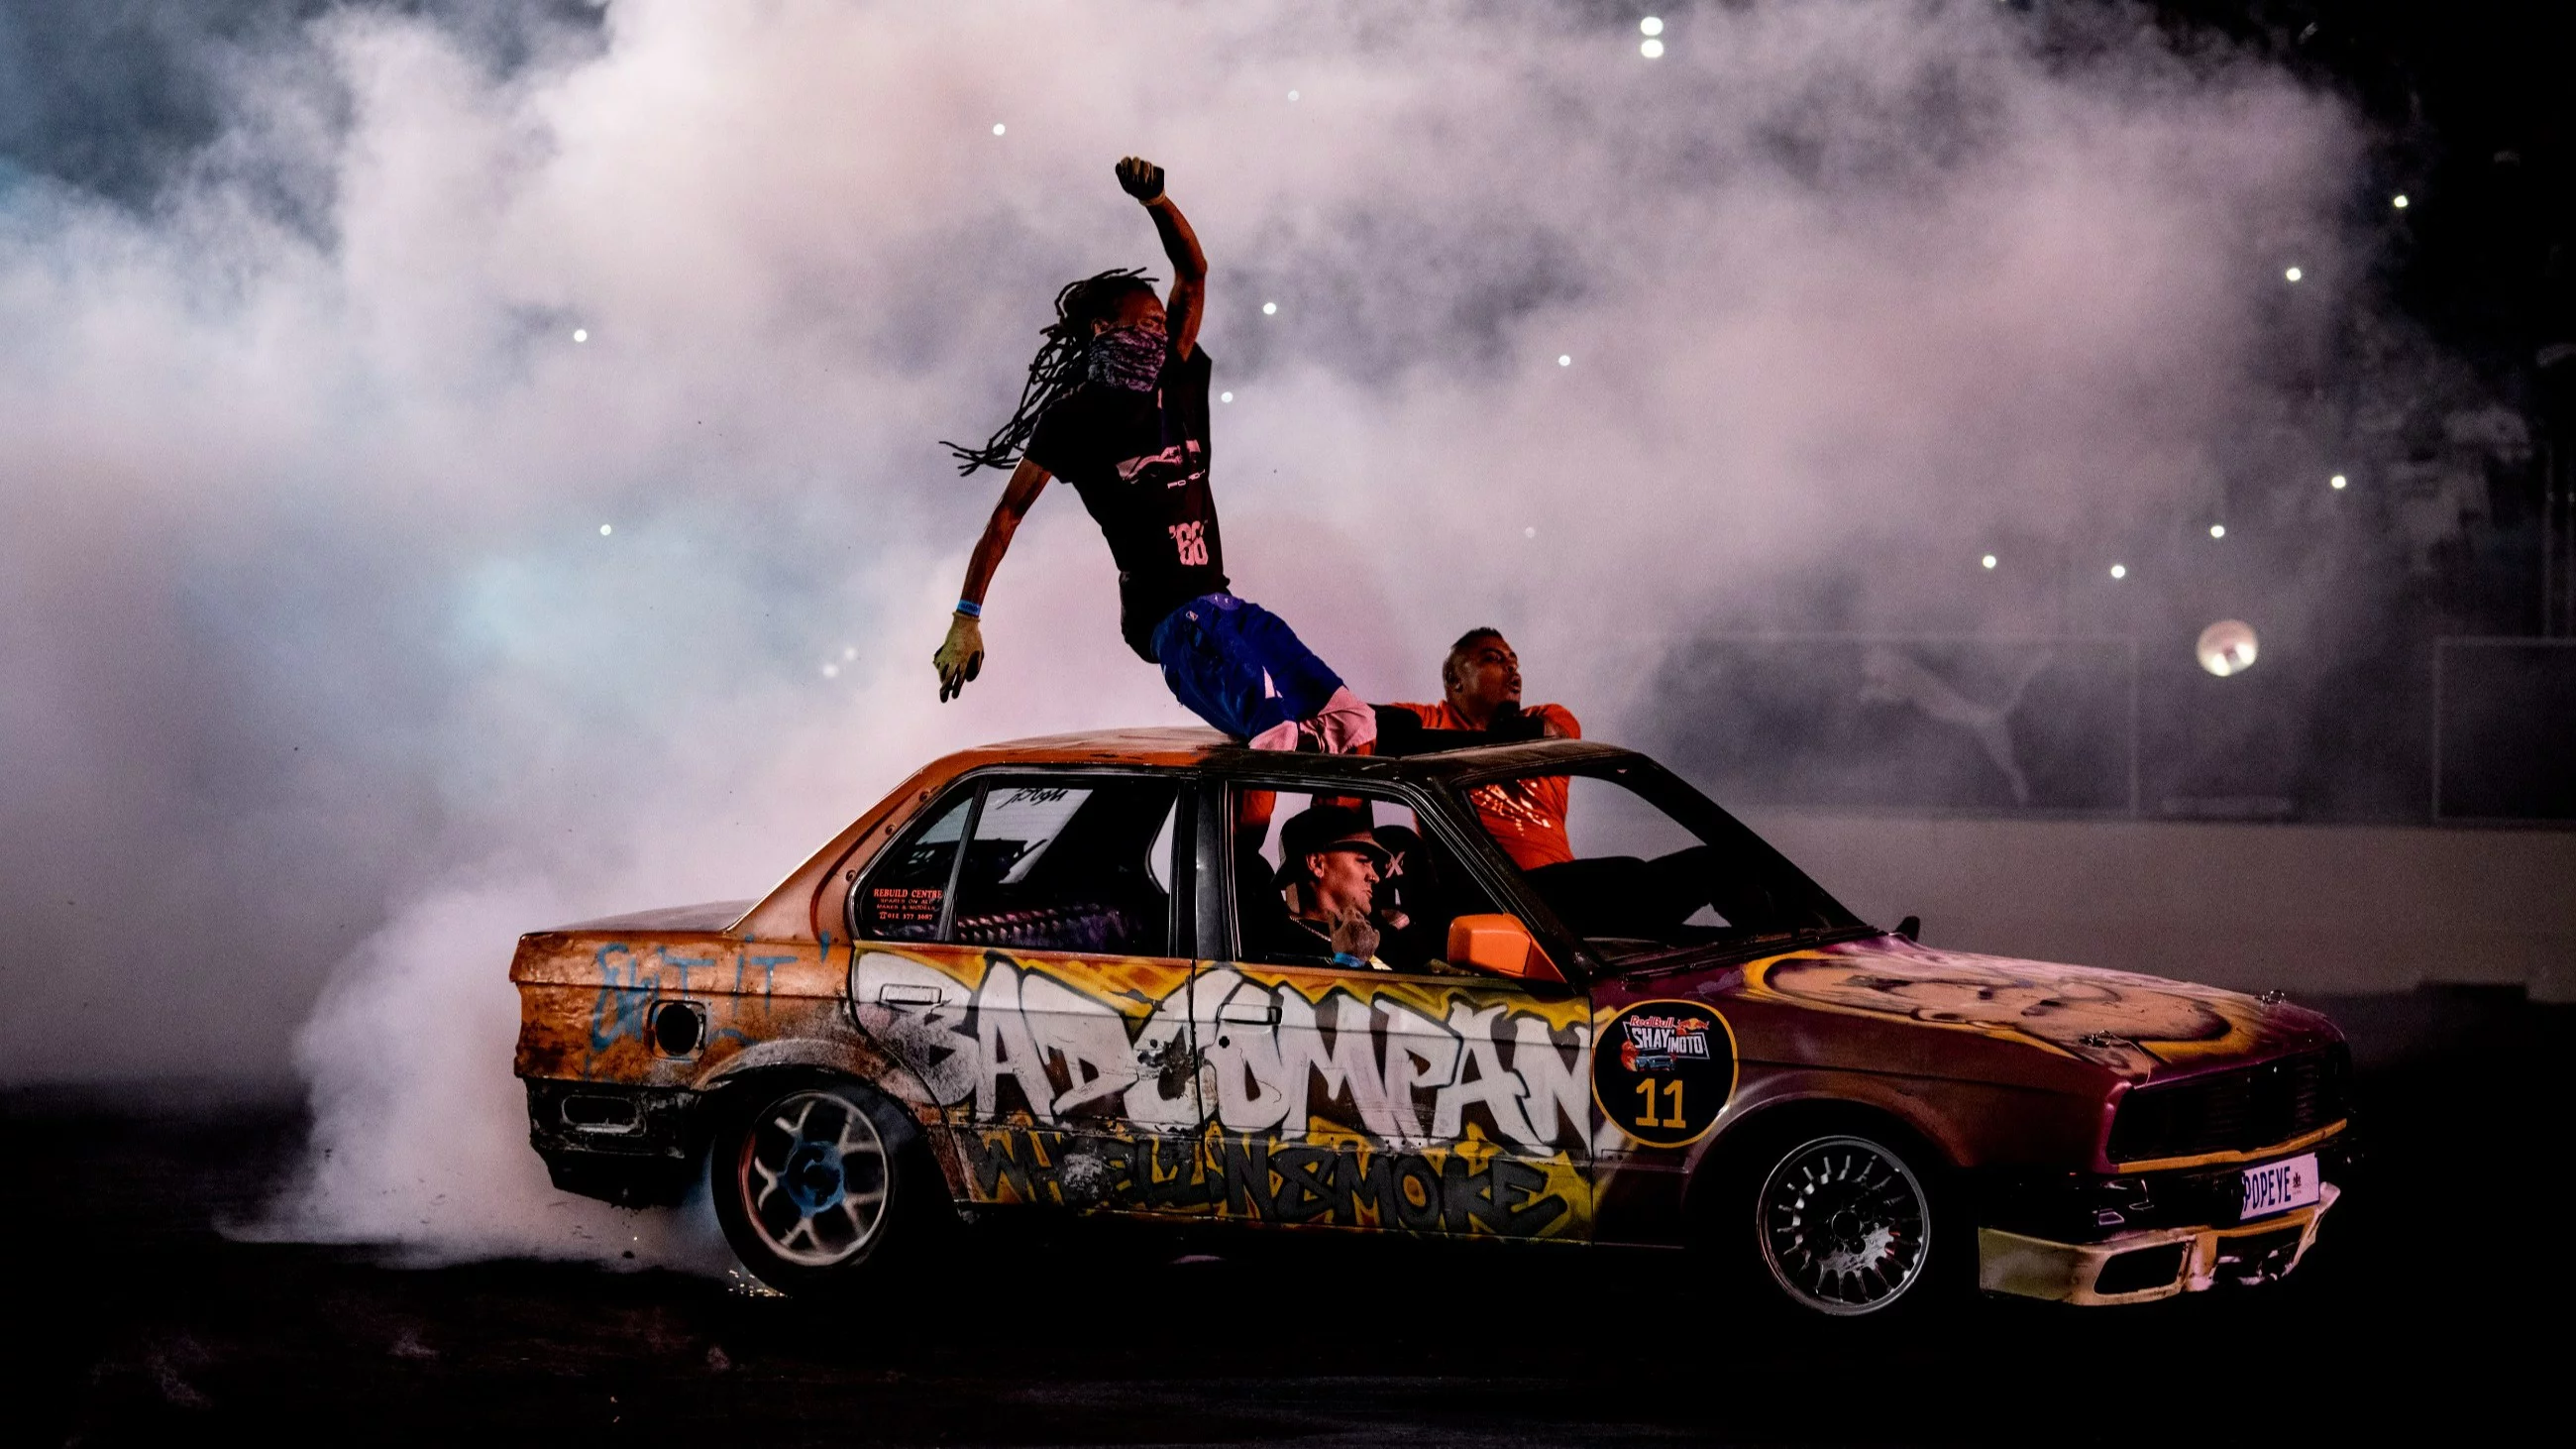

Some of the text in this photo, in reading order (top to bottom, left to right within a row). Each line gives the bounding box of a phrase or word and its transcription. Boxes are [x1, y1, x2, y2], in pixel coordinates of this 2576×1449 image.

[873, 888, 943, 900] REBUILD CENTRE
[853, 947, 1139, 1130] BAD
[1636, 1077, 1686, 1129] 11
[2243, 1166, 2292, 1212] POPEYE
